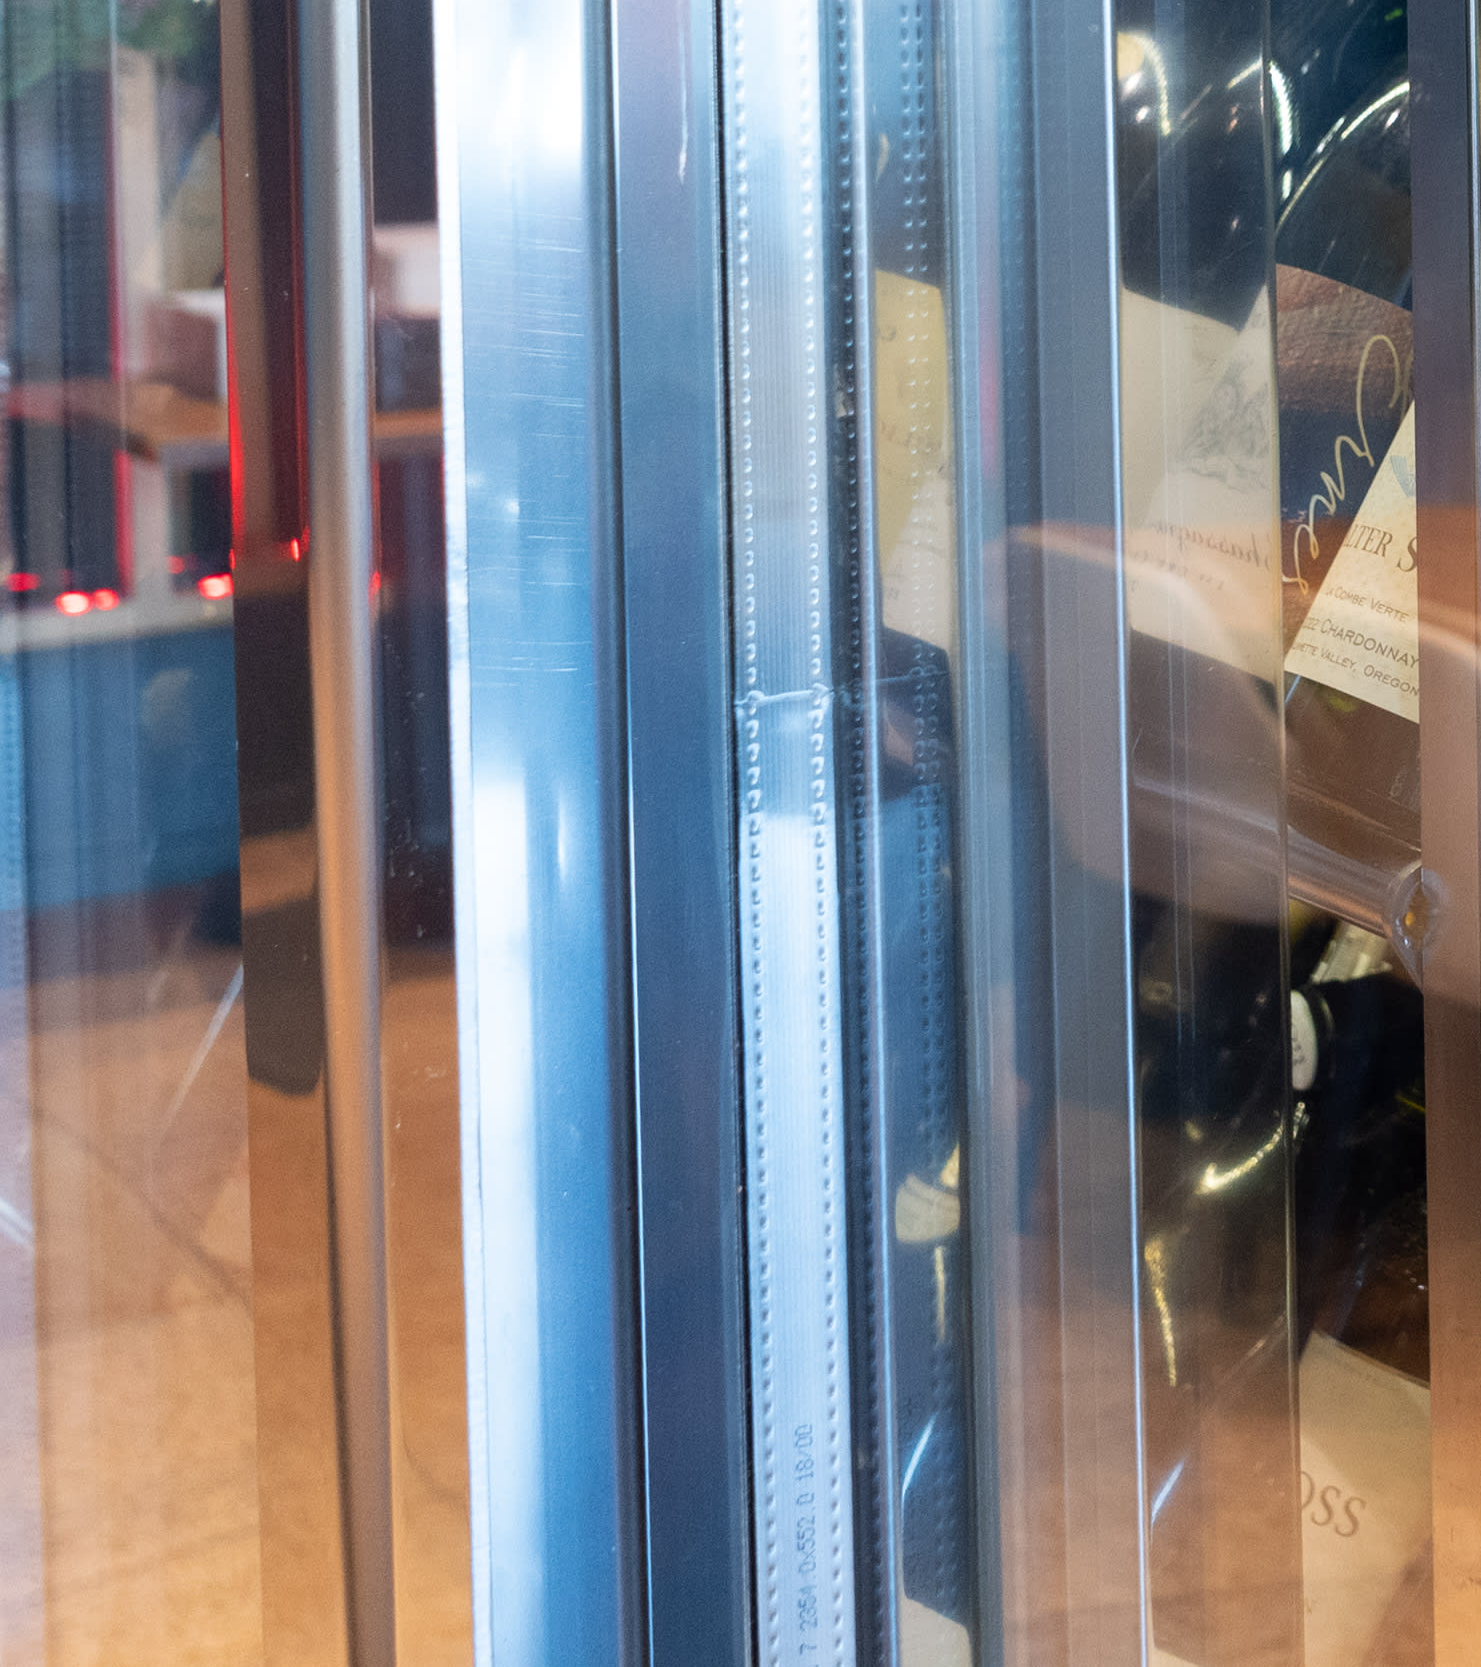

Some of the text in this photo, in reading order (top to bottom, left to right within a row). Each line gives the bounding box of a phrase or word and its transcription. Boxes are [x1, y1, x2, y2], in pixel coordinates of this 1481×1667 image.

[1370, 599, 1411, 623] VERTE
[1320, 617, 1420, 670] CHARDONNAY
[1363, 663, 1419, 698] OREGON
